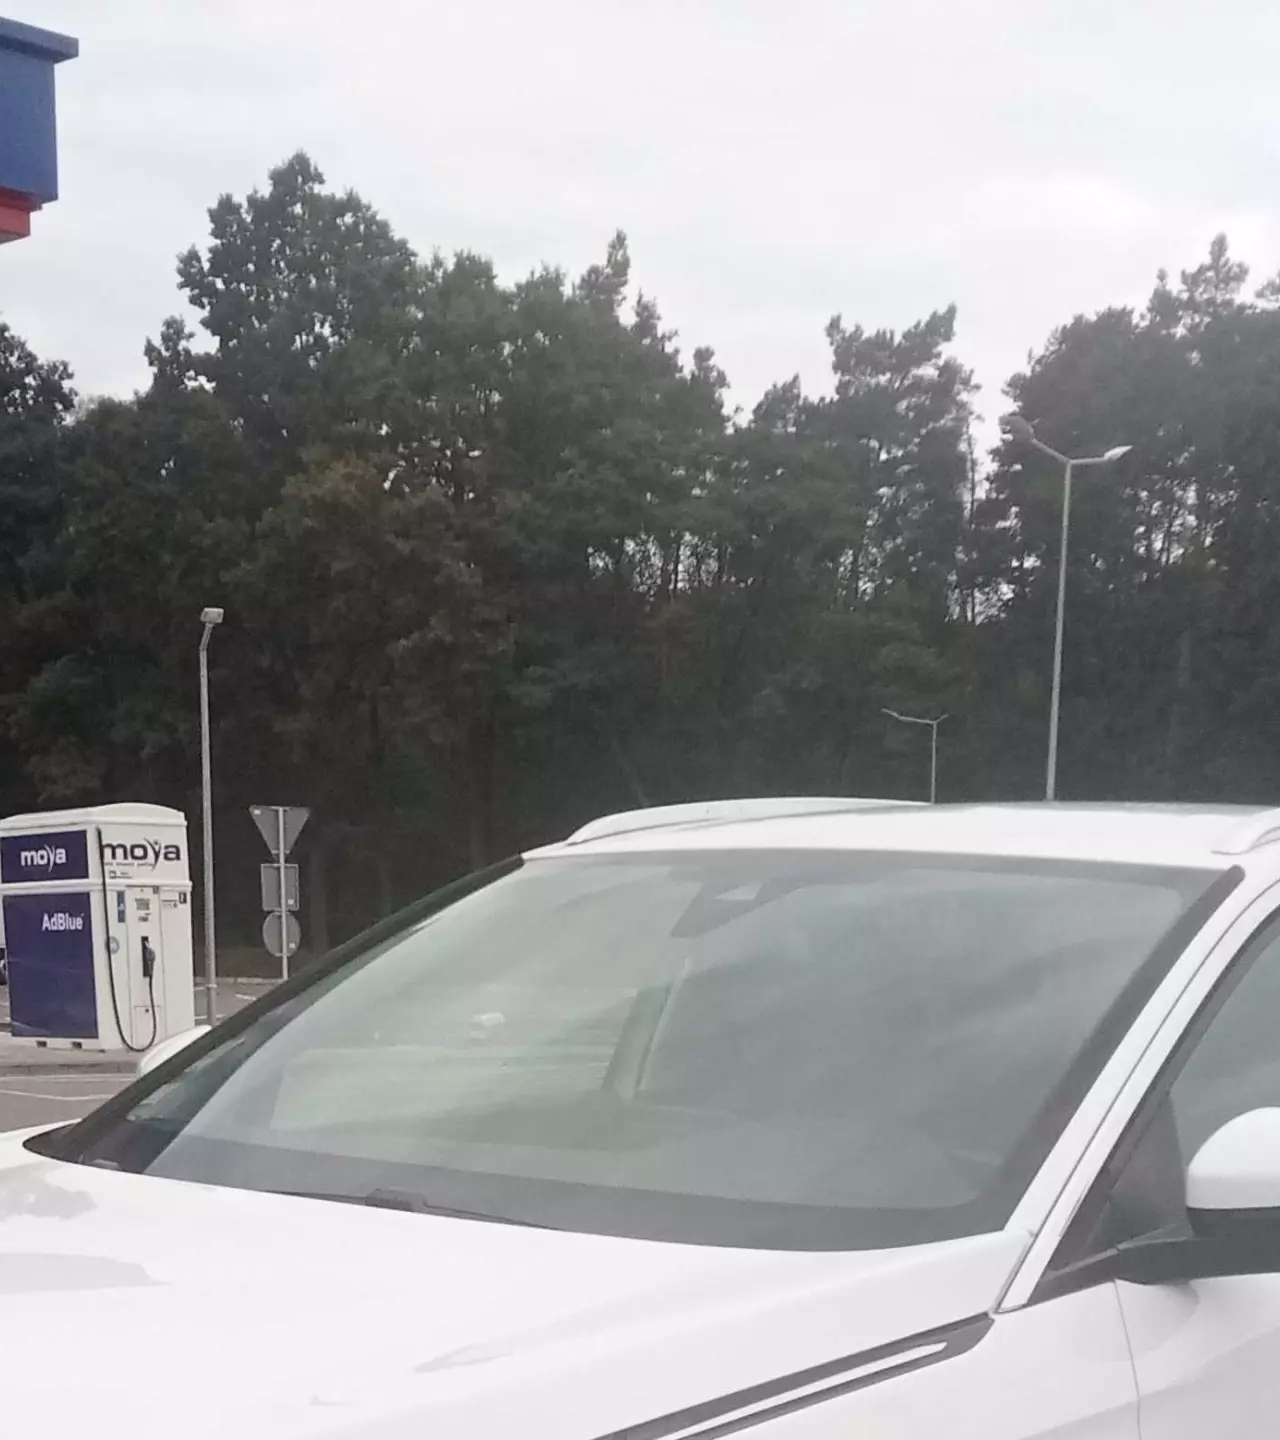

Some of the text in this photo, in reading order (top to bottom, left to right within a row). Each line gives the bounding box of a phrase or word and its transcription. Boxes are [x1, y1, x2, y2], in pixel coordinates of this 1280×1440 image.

[21, 844, 67, 872] moya
[102, 837, 182, 871] moya
[41, 912, 84, 931] AdBlue
